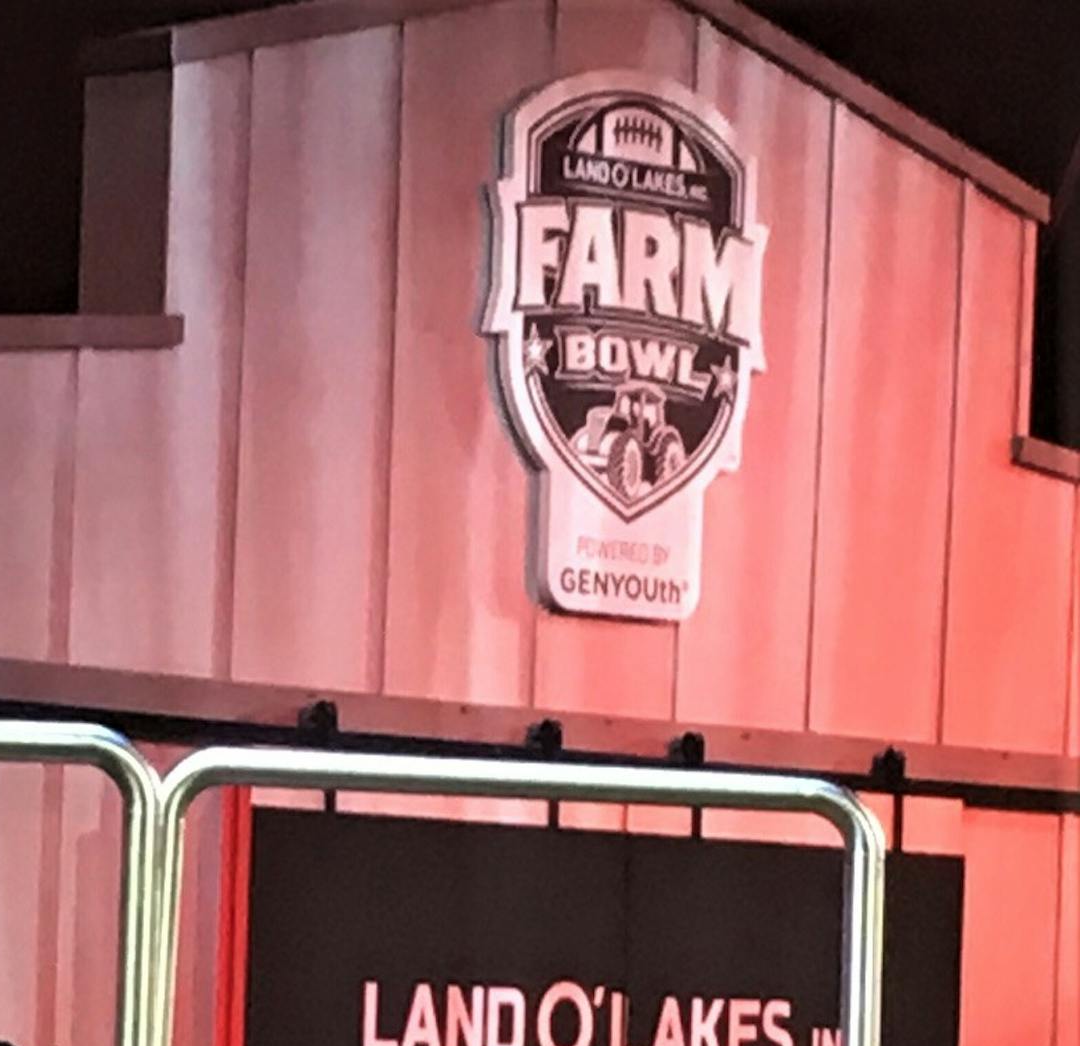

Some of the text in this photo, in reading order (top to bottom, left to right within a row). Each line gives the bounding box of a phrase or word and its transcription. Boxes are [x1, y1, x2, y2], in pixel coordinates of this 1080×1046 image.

[563, 156, 610, 184] LAND
[518, 203, 755, 341] FARM
[565, 333, 708, 391] BOWL
